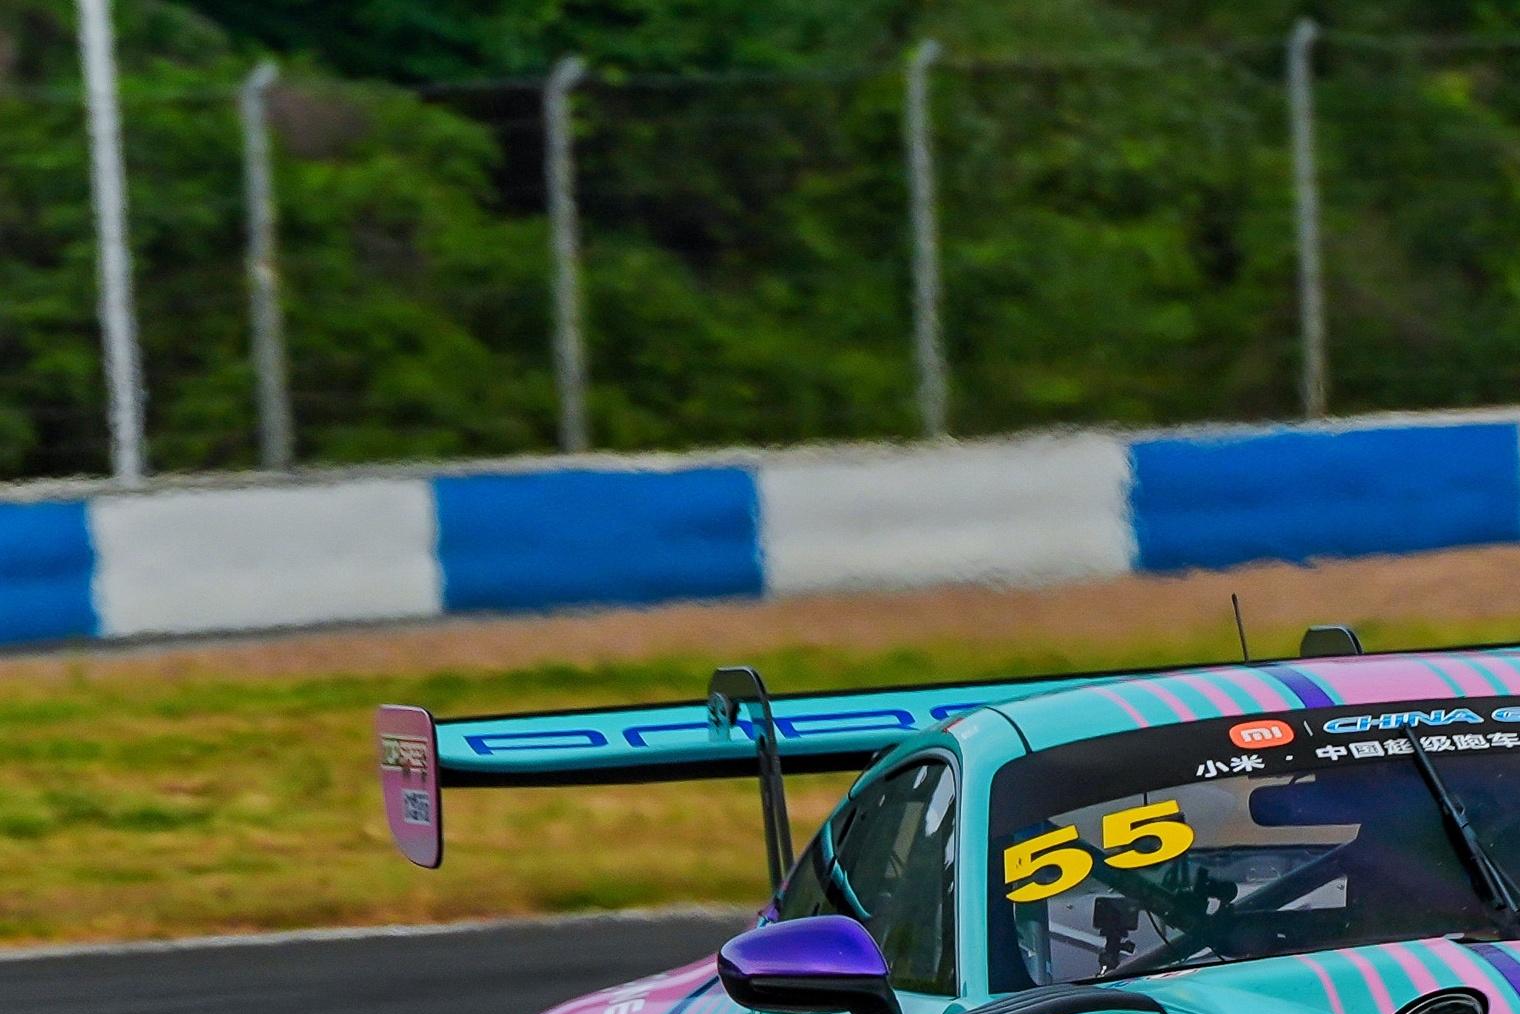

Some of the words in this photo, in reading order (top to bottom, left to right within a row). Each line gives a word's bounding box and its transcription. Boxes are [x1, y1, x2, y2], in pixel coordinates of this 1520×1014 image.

[1323, 708, 1484, 734] CHINA
[1196, 753, 1265, 778] 小米
[1003, 800, 1195, 902] 55
